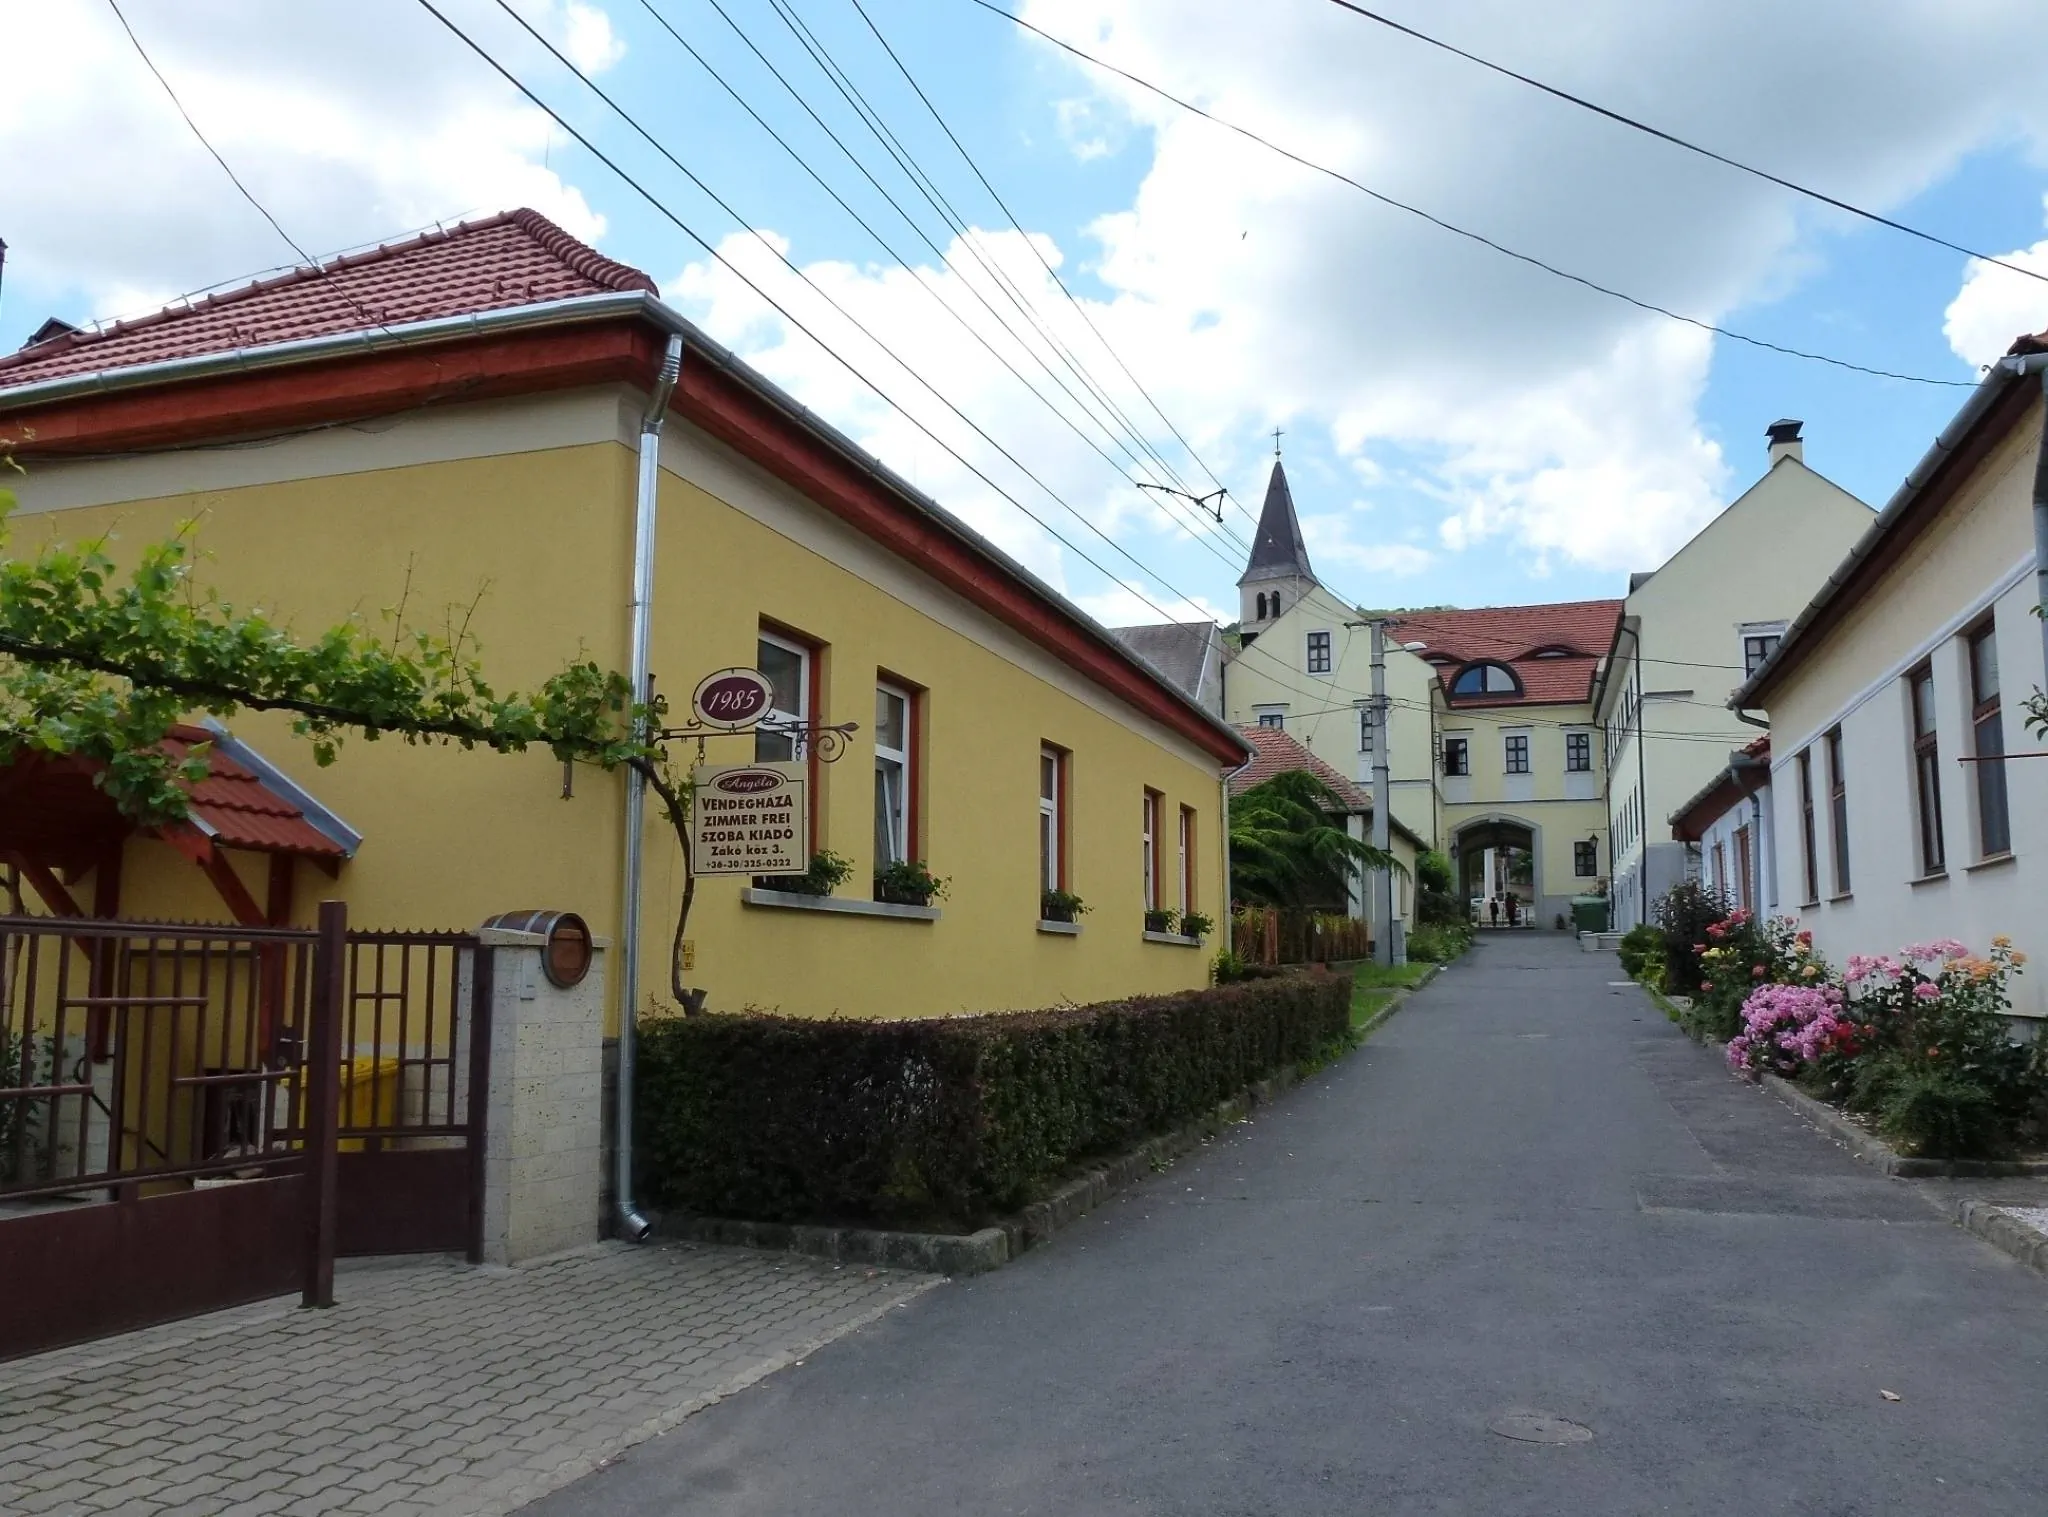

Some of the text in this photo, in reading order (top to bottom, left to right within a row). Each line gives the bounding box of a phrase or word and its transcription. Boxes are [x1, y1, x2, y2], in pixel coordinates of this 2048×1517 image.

[709, 689, 759, 711] 1985
[704, 813, 790, 827] ZIMMER FREI
[701, 825, 794, 843] SZOBA KIADÓ
[772, 844, 784, 854] 3.
